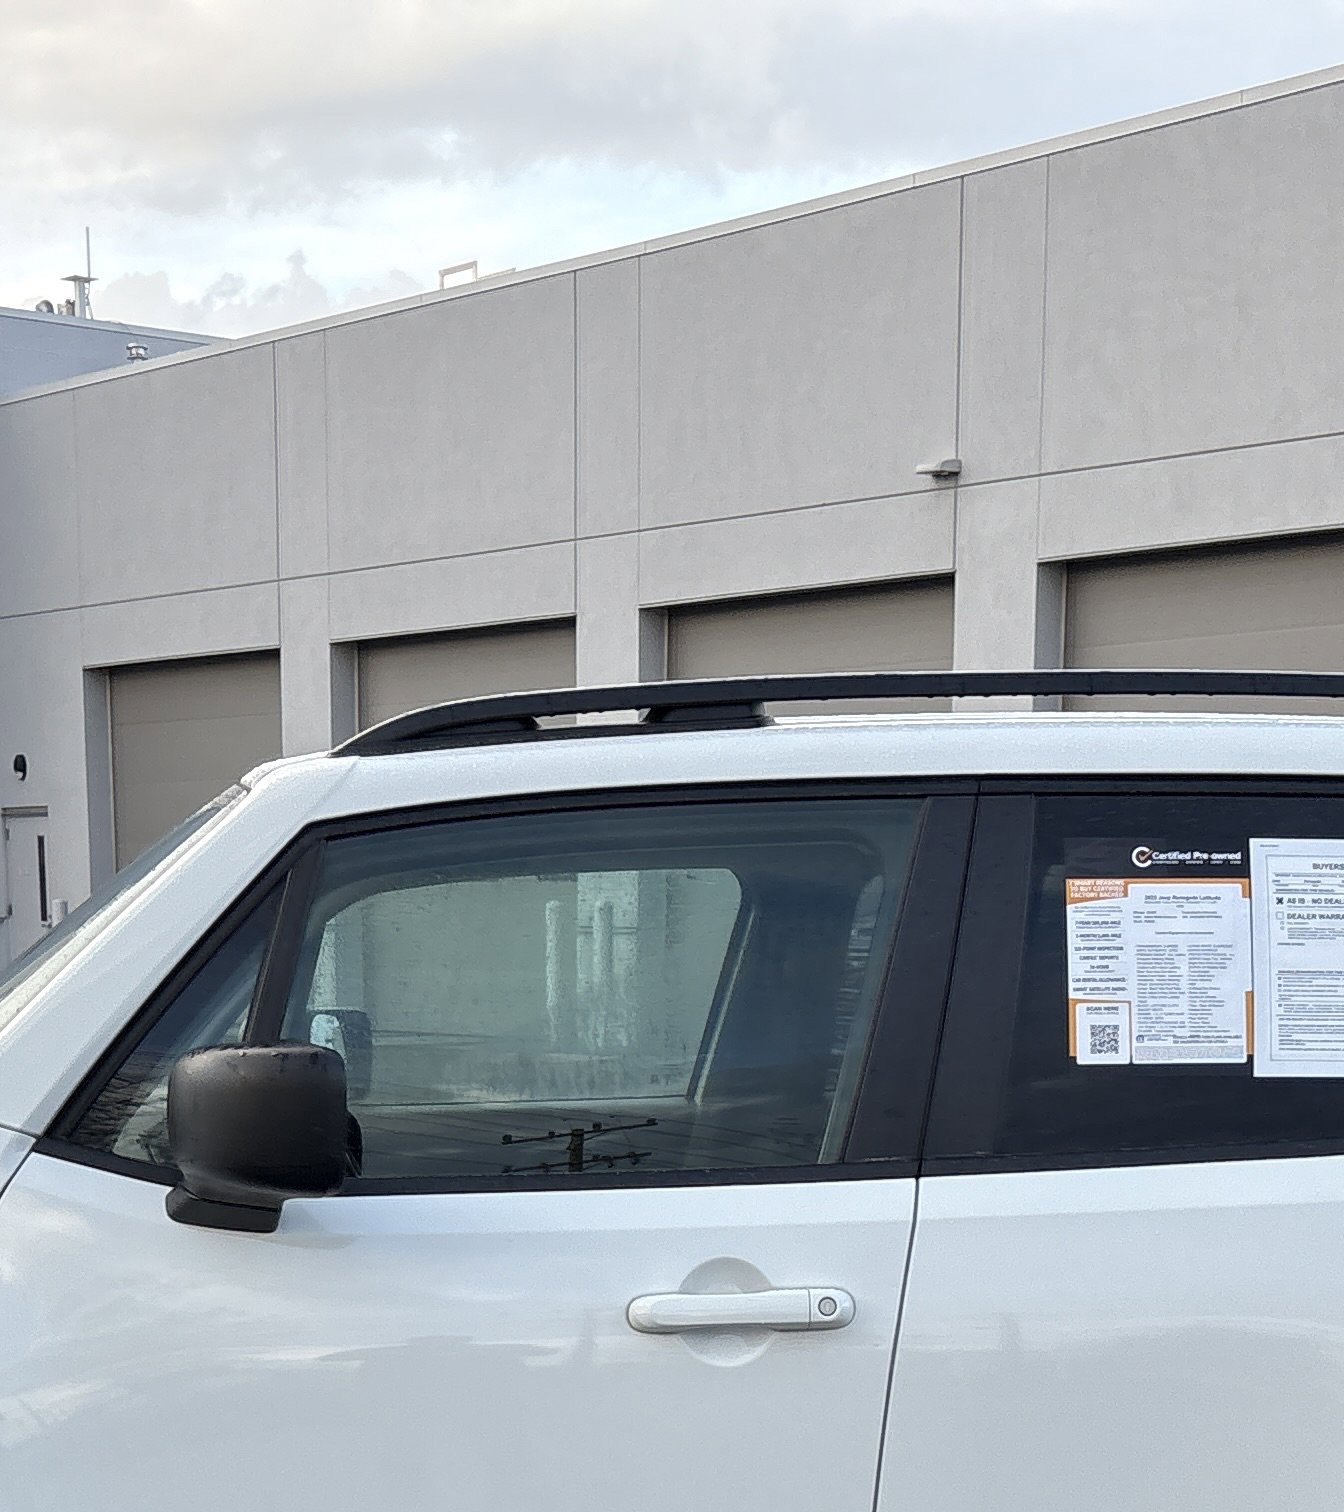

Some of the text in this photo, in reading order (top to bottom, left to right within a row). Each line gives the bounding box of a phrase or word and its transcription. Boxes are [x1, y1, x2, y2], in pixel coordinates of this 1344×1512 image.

[1151, 851, 1242, 860] Certified Pre-owned
[1312, 863, 1344, 871] BUYERS
